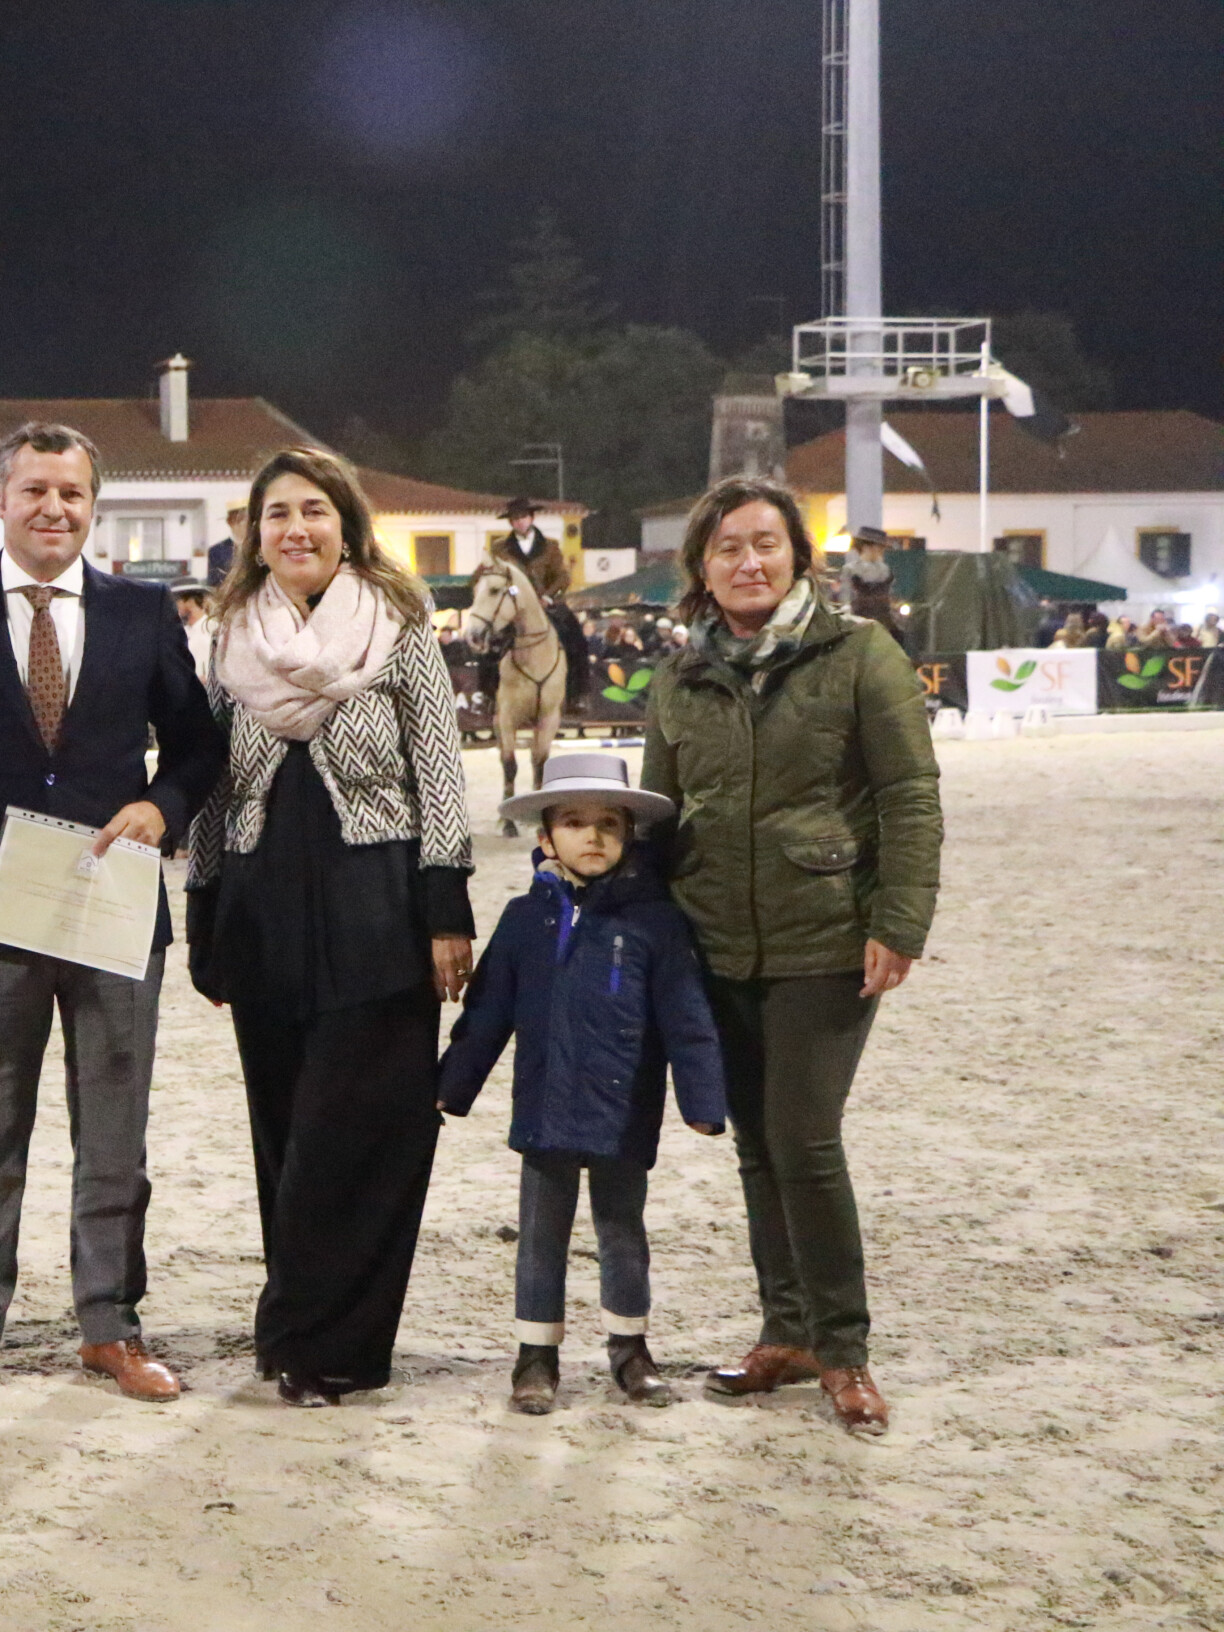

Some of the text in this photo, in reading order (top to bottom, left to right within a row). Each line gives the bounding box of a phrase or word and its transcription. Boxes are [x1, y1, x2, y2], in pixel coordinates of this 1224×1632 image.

[916, 663, 949, 694] SF
[1040, 660, 1073, 692] SF
[1168, 656, 1203, 688] SF
